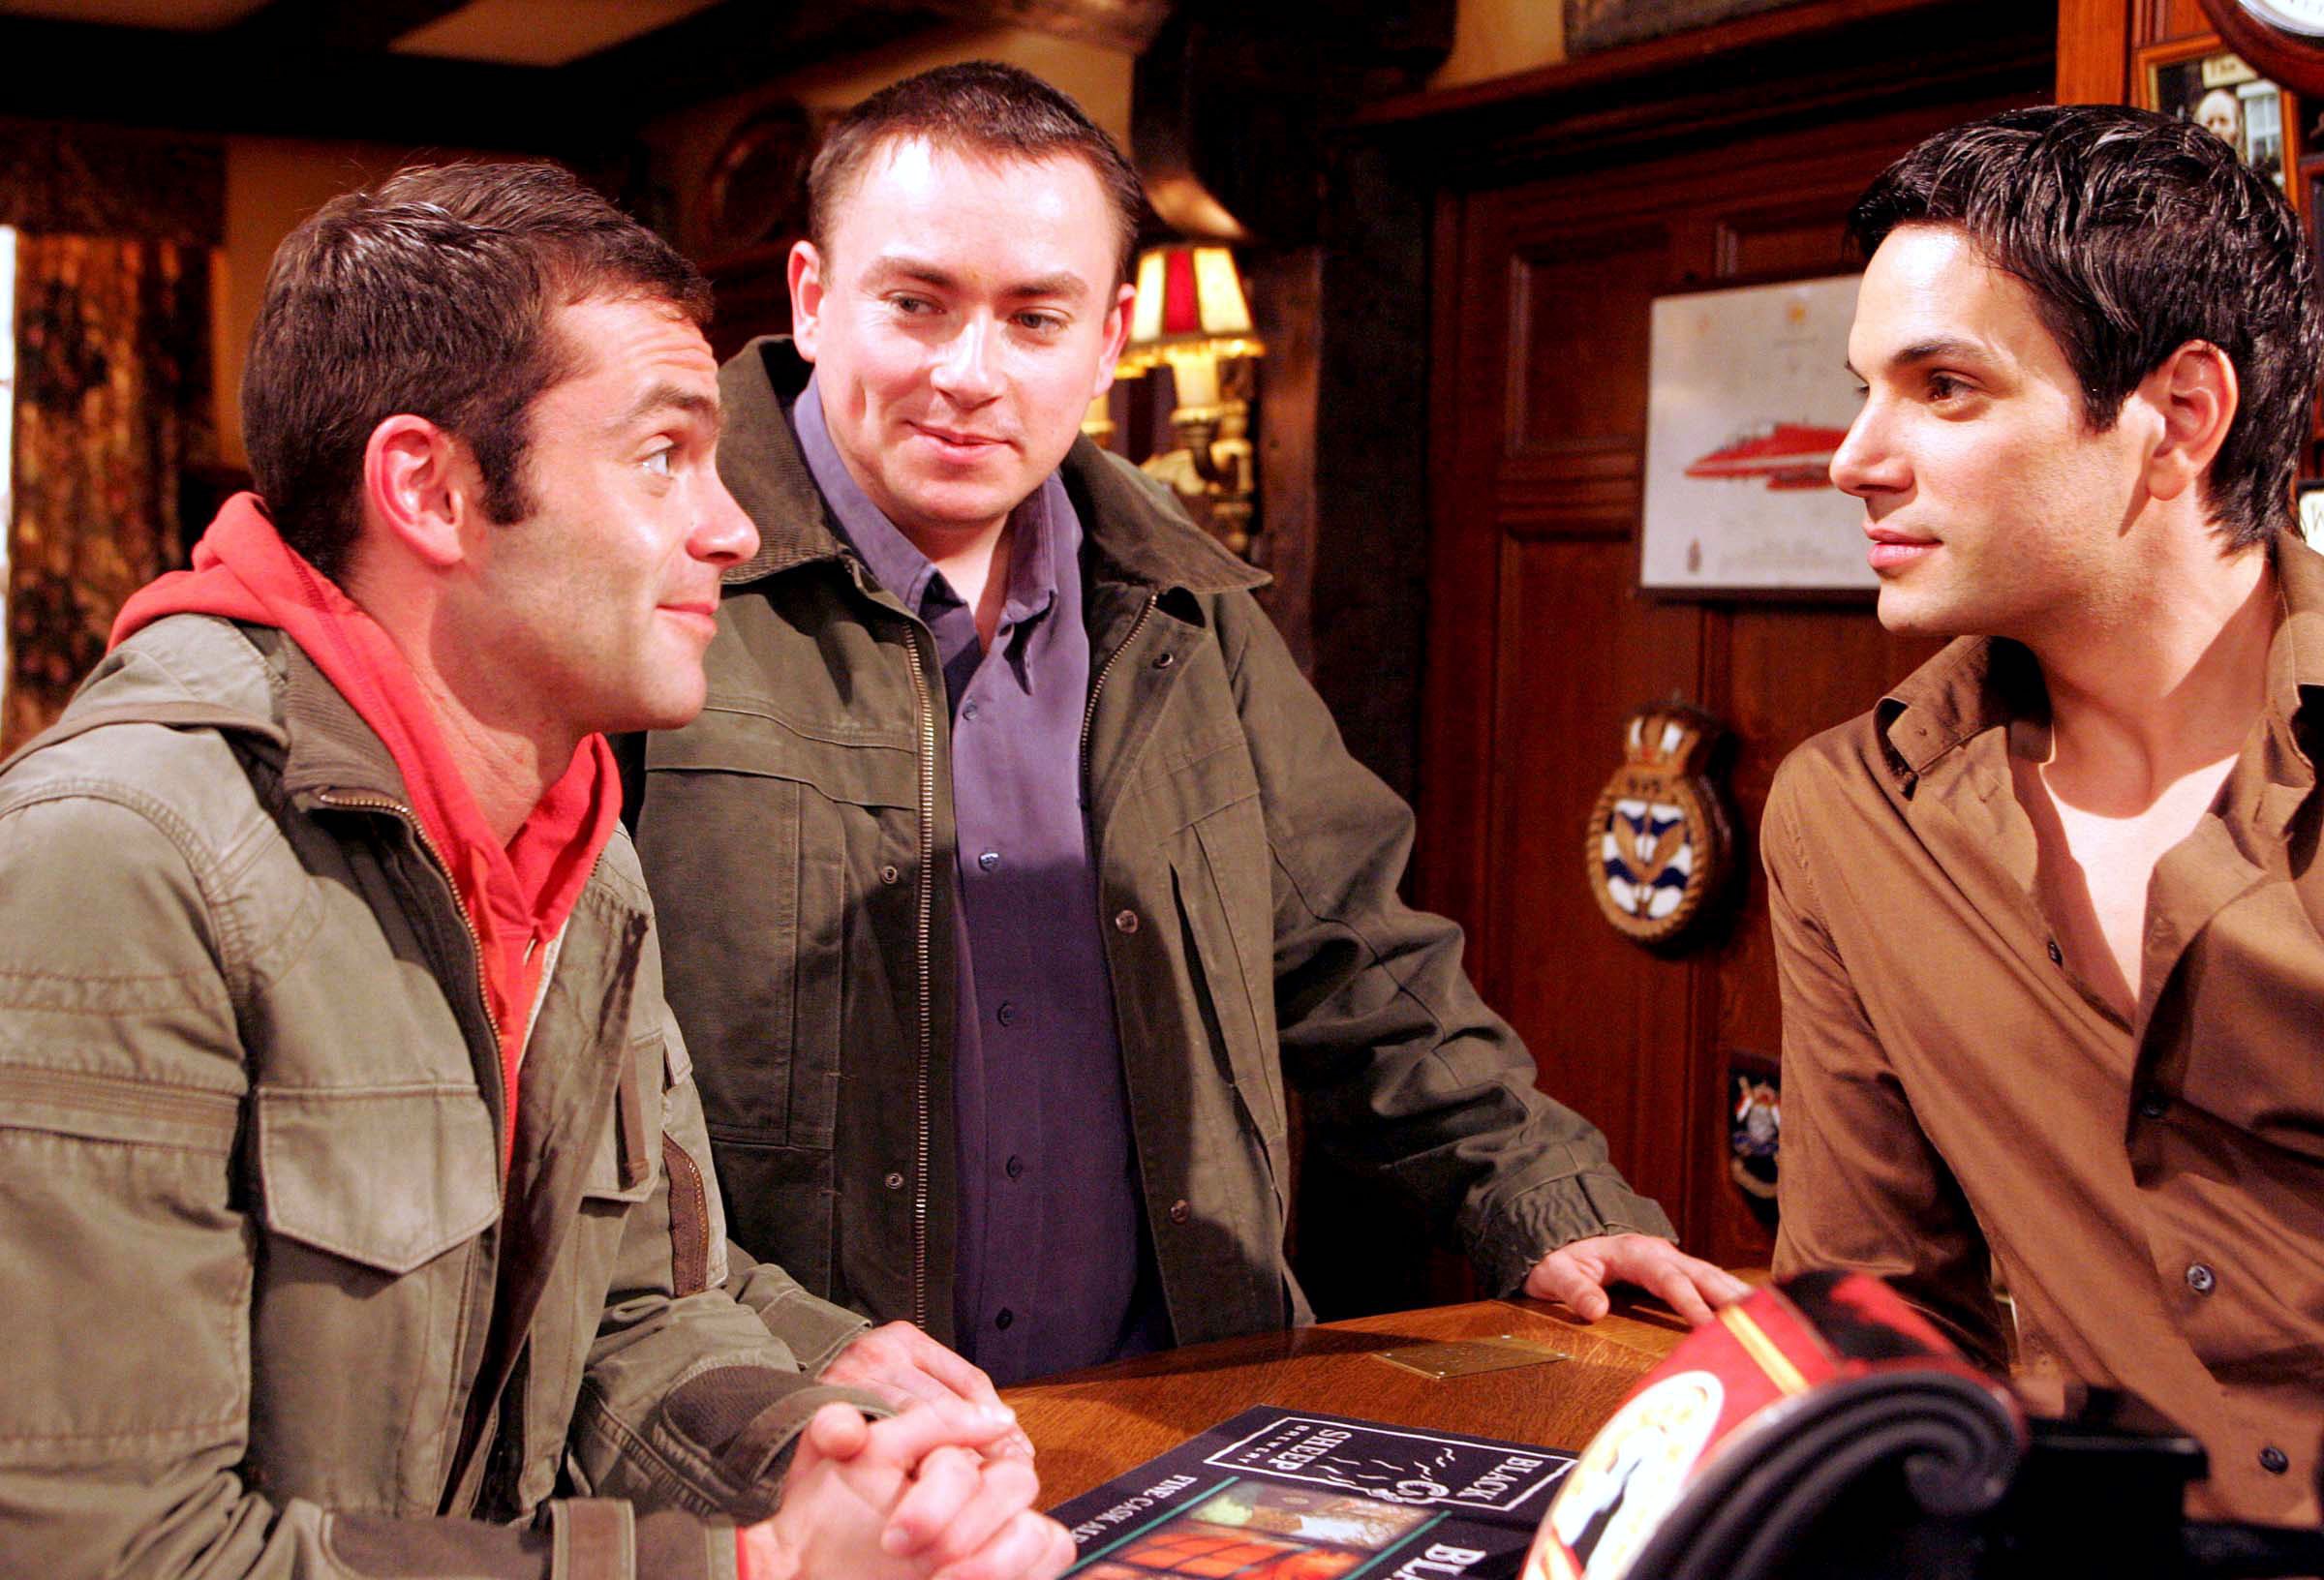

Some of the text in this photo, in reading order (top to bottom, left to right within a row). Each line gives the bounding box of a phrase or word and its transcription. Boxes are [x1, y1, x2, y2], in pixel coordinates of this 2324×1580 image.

[1238, 1425, 1310, 1464] BREWERY
[1268, 1429, 1352, 1471] SHEEP
[1143, 1474, 1198, 1499] FINE
[1456, 1456, 1544, 1501] BLACK
[1094, 1497, 1154, 1524] CASK
